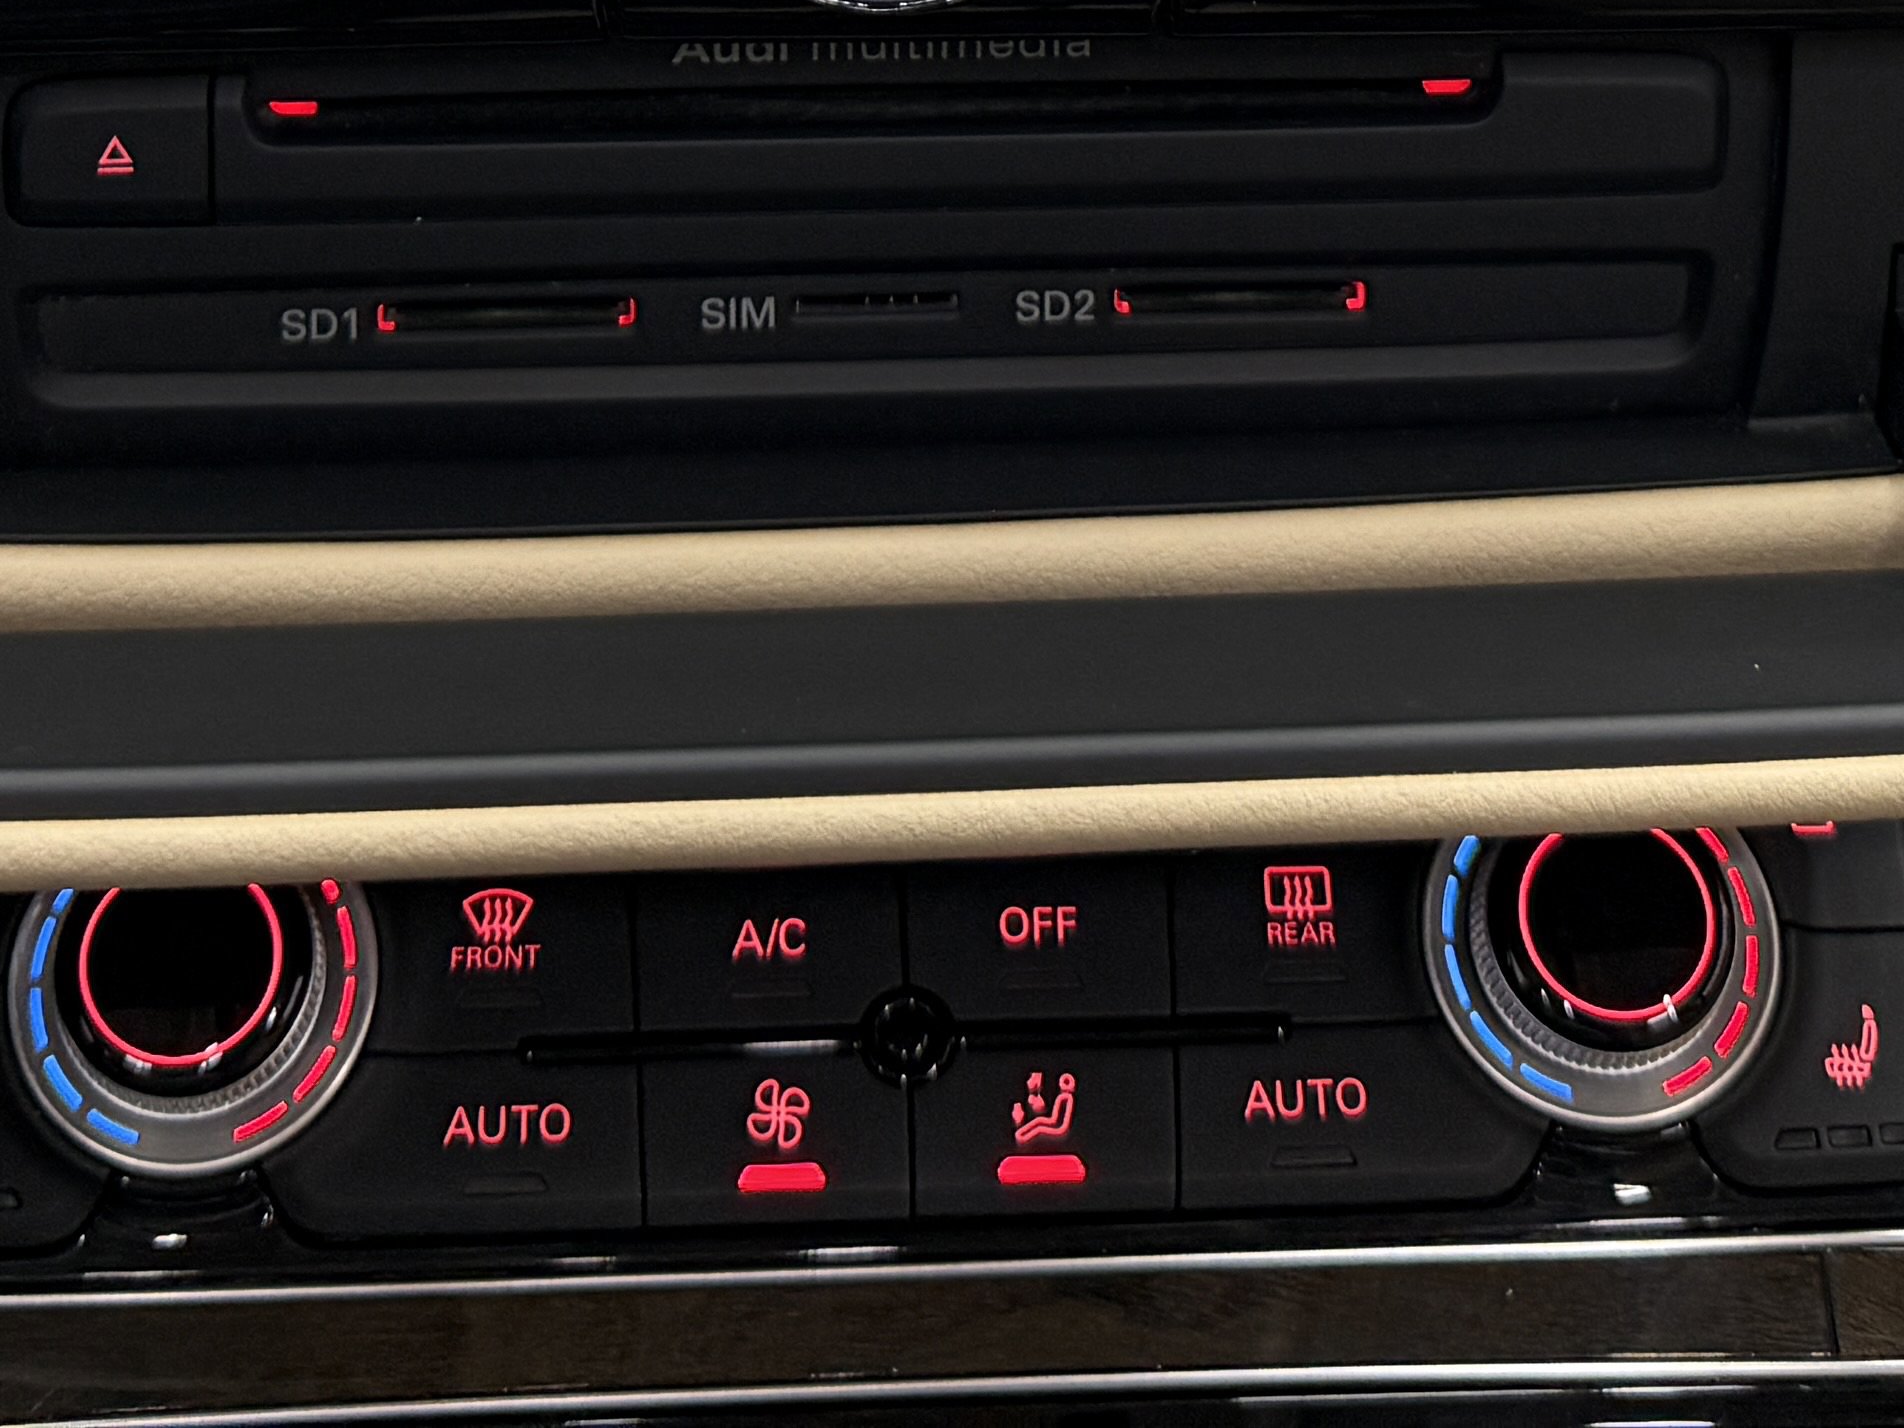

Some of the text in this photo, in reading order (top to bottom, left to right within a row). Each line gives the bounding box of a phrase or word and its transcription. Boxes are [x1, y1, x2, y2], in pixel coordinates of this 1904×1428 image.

[280, 288, 1096, 343] SD1 SIM SD2
[732, 917, 807, 961] A/C
[998, 905, 1079, 946] OFF
[1267, 921, 1337, 947] REAR
[450, 944, 542, 972] FRONT
[1244, 1077, 1369, 1122] AUTO
[443, 1103, 573, 1147] AUTO
